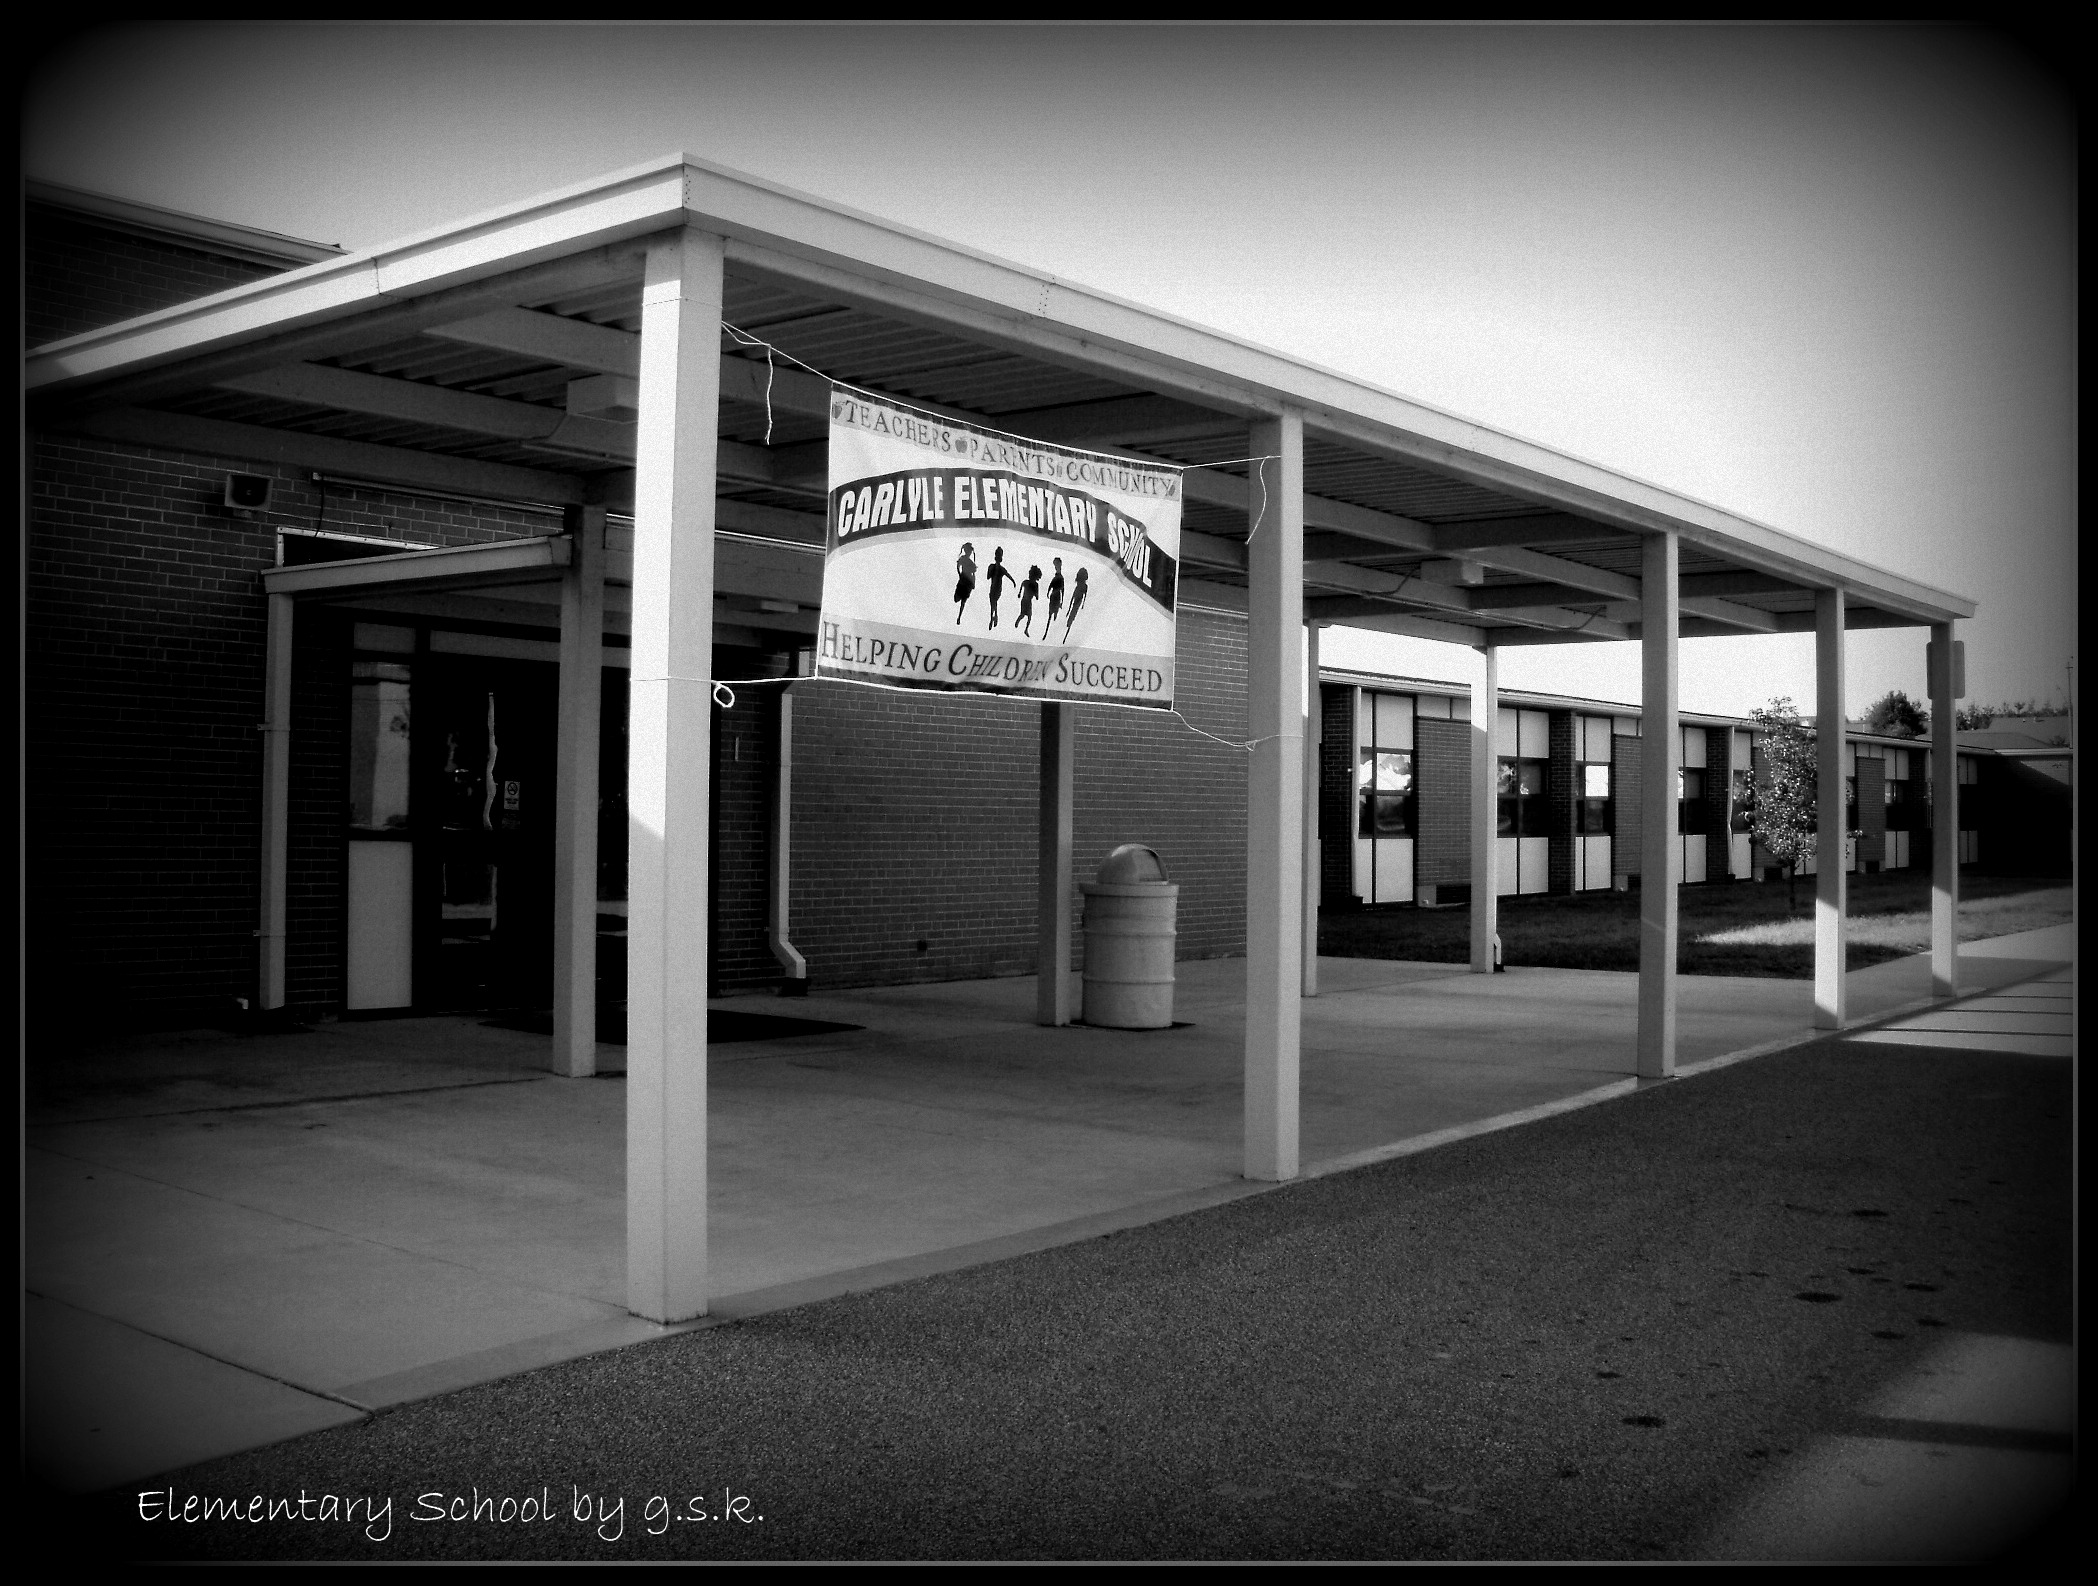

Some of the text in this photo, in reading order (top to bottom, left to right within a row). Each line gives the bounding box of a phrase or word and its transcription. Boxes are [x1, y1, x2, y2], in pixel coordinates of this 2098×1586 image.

[845, 399, 951, 452] TEACHERS
[1066, 461, 1175, 497] COMMUNITY
[837, 475, 945, 538] CARLYLE
[954, 475, 1097, 543] ELEMENTARY
[821, 620, 941, 673] HELPING
[1055, 652, 1162, 693] SUCCEED
